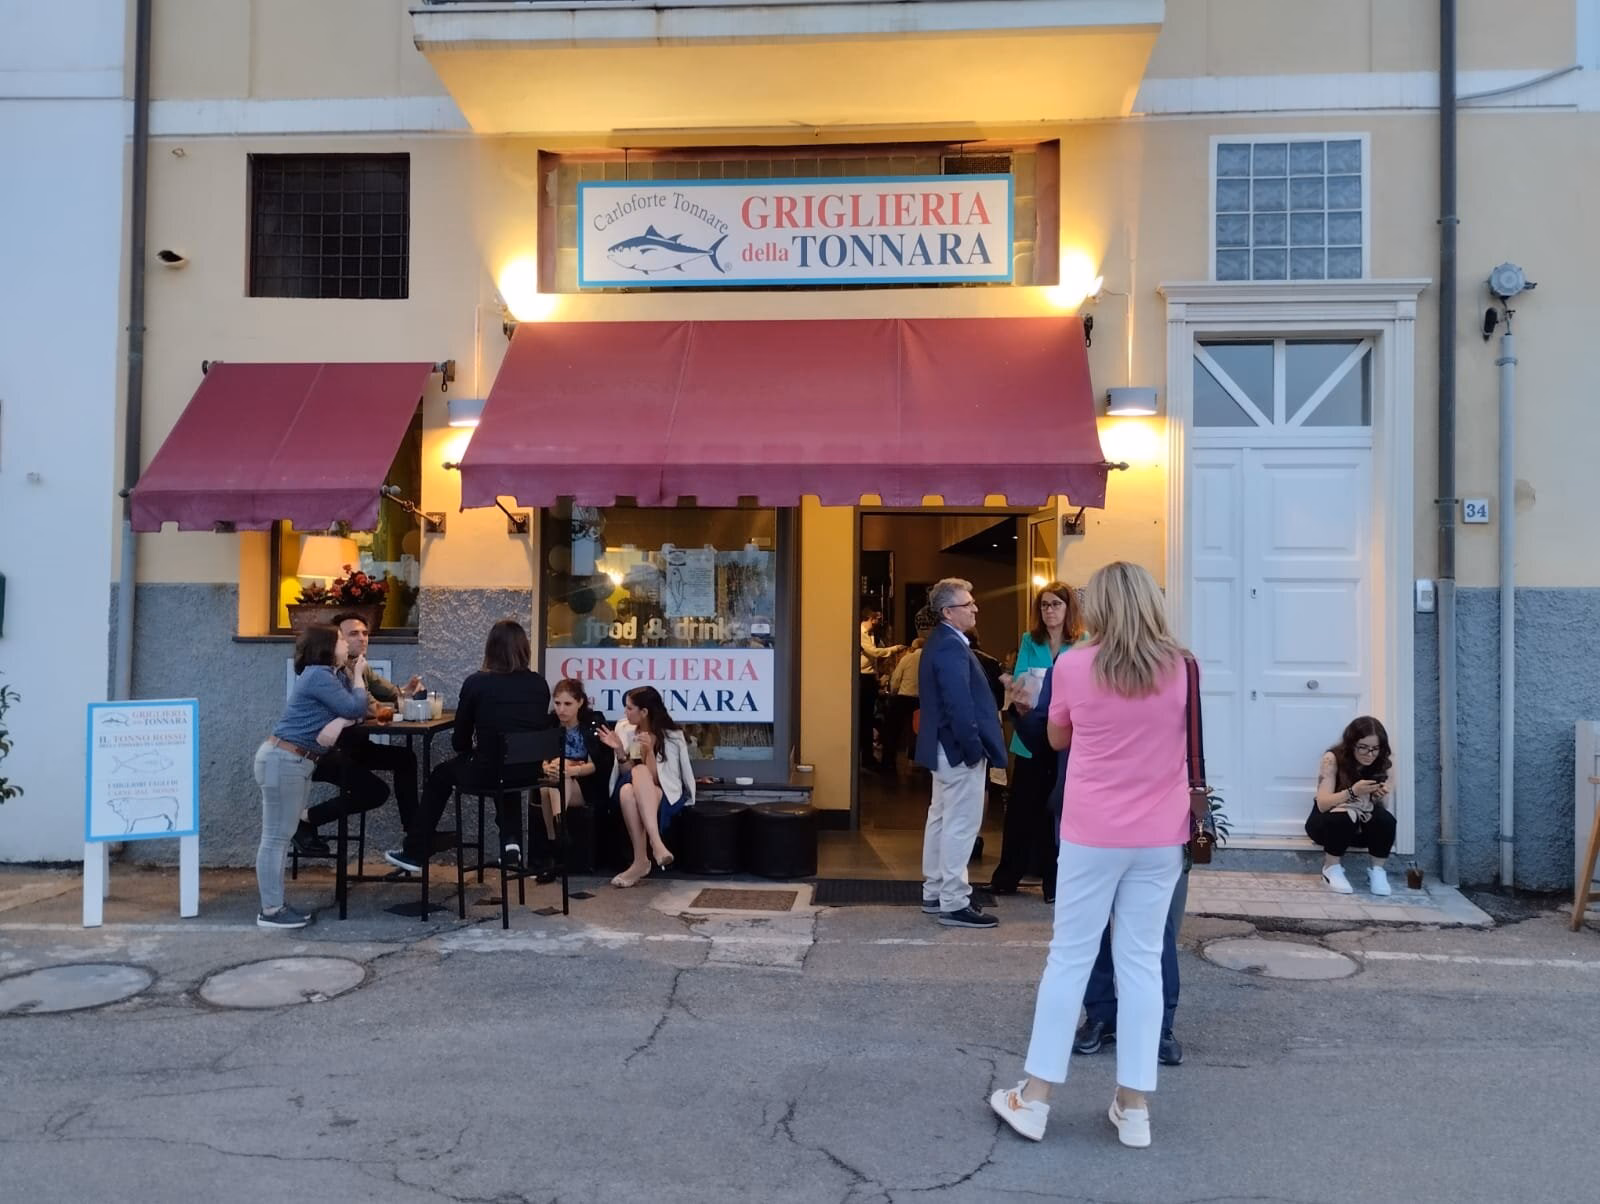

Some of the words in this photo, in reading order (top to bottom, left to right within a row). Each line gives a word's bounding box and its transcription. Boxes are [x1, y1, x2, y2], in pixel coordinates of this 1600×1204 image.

[593, 193, 667, 231] Carloforte
[673, 192, 729, 235] Tonnare
[741, 191, 992, 230] GRIGLIERIA
[742, 242, 789, 262] della
[792, 232, 993, 268] TONNARA
[1466, 503, 1487, 518] 34
[583, 616, 637, 644] food
[644, 617, 668, 640] &
[560, 657, 759, 681] GRIGLIERIA
[601, 688, 759, 712] TNARA
[144, 717, 188, 726] TONNARA
